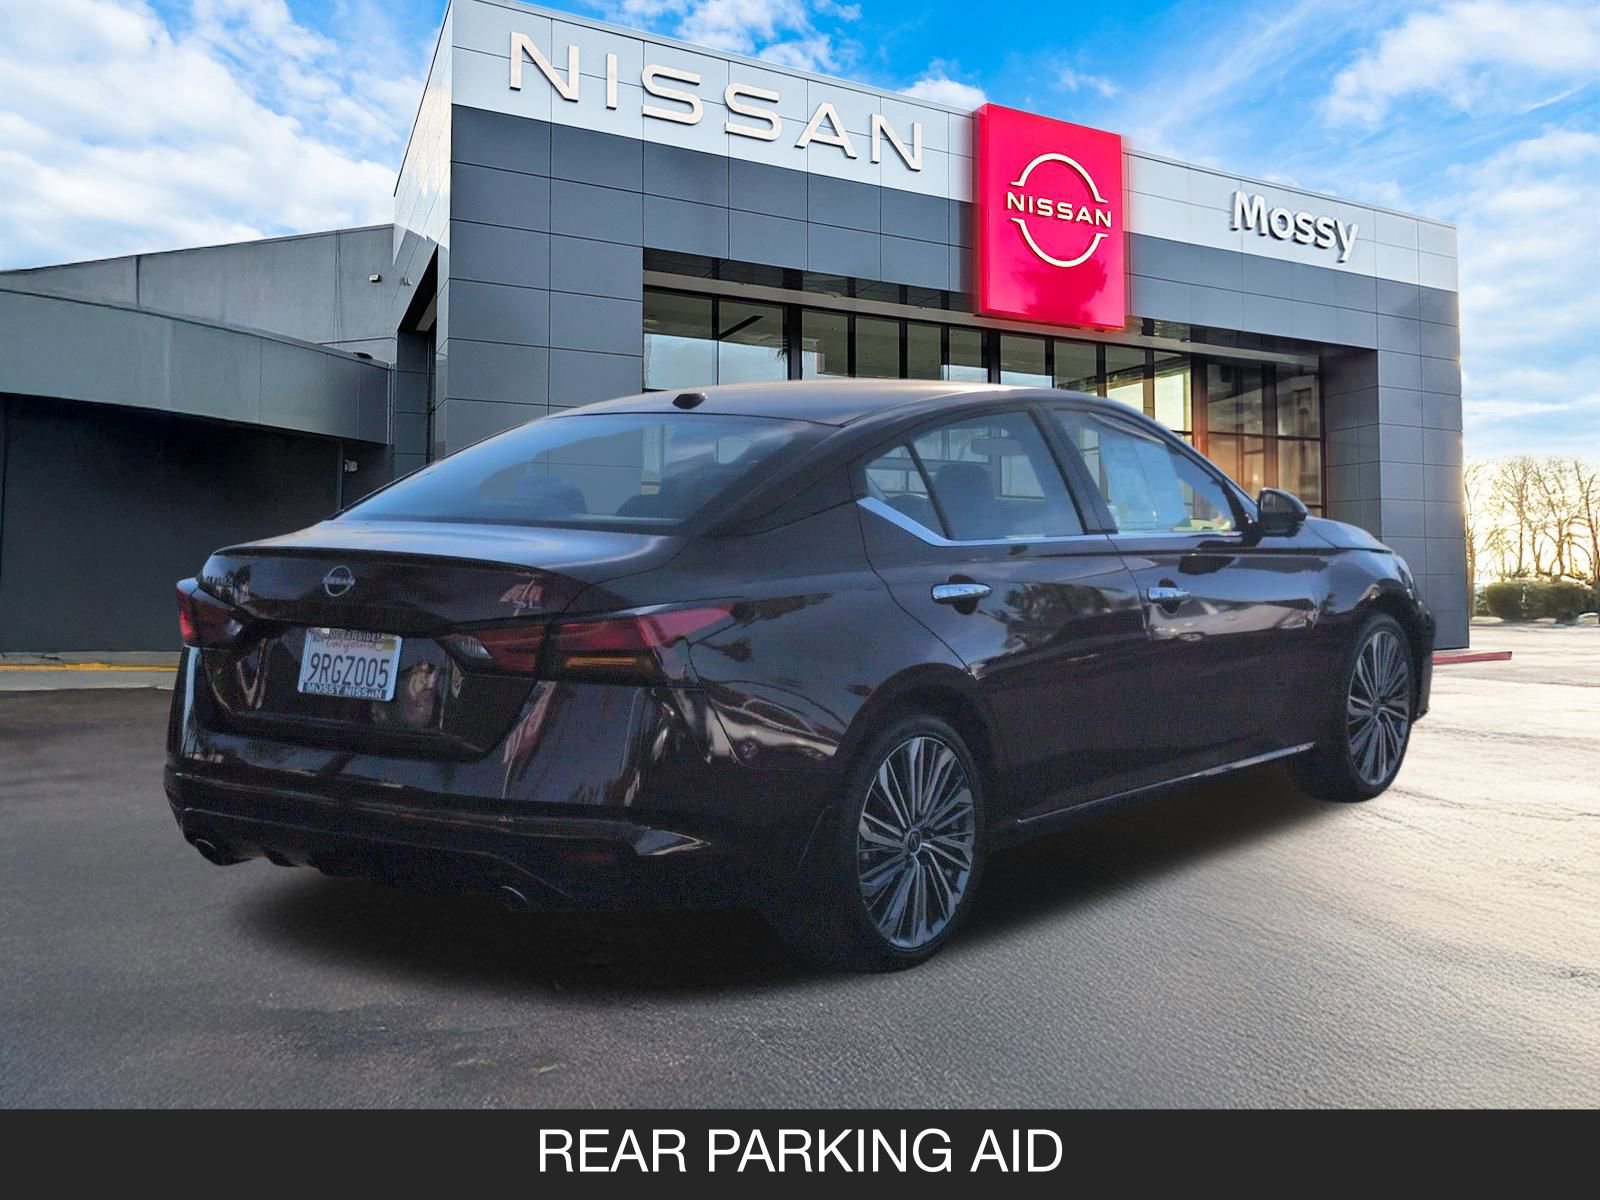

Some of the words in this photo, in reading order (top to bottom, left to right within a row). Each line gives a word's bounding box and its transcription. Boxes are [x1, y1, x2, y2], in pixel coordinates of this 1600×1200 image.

[509, 31, 923, 172] NISSAN
[1006, 191, 1112, 228] NISSAN
[1230, 190, 1360, 263] Mossy
[308, 652, 390, 689] 9RGZ005
